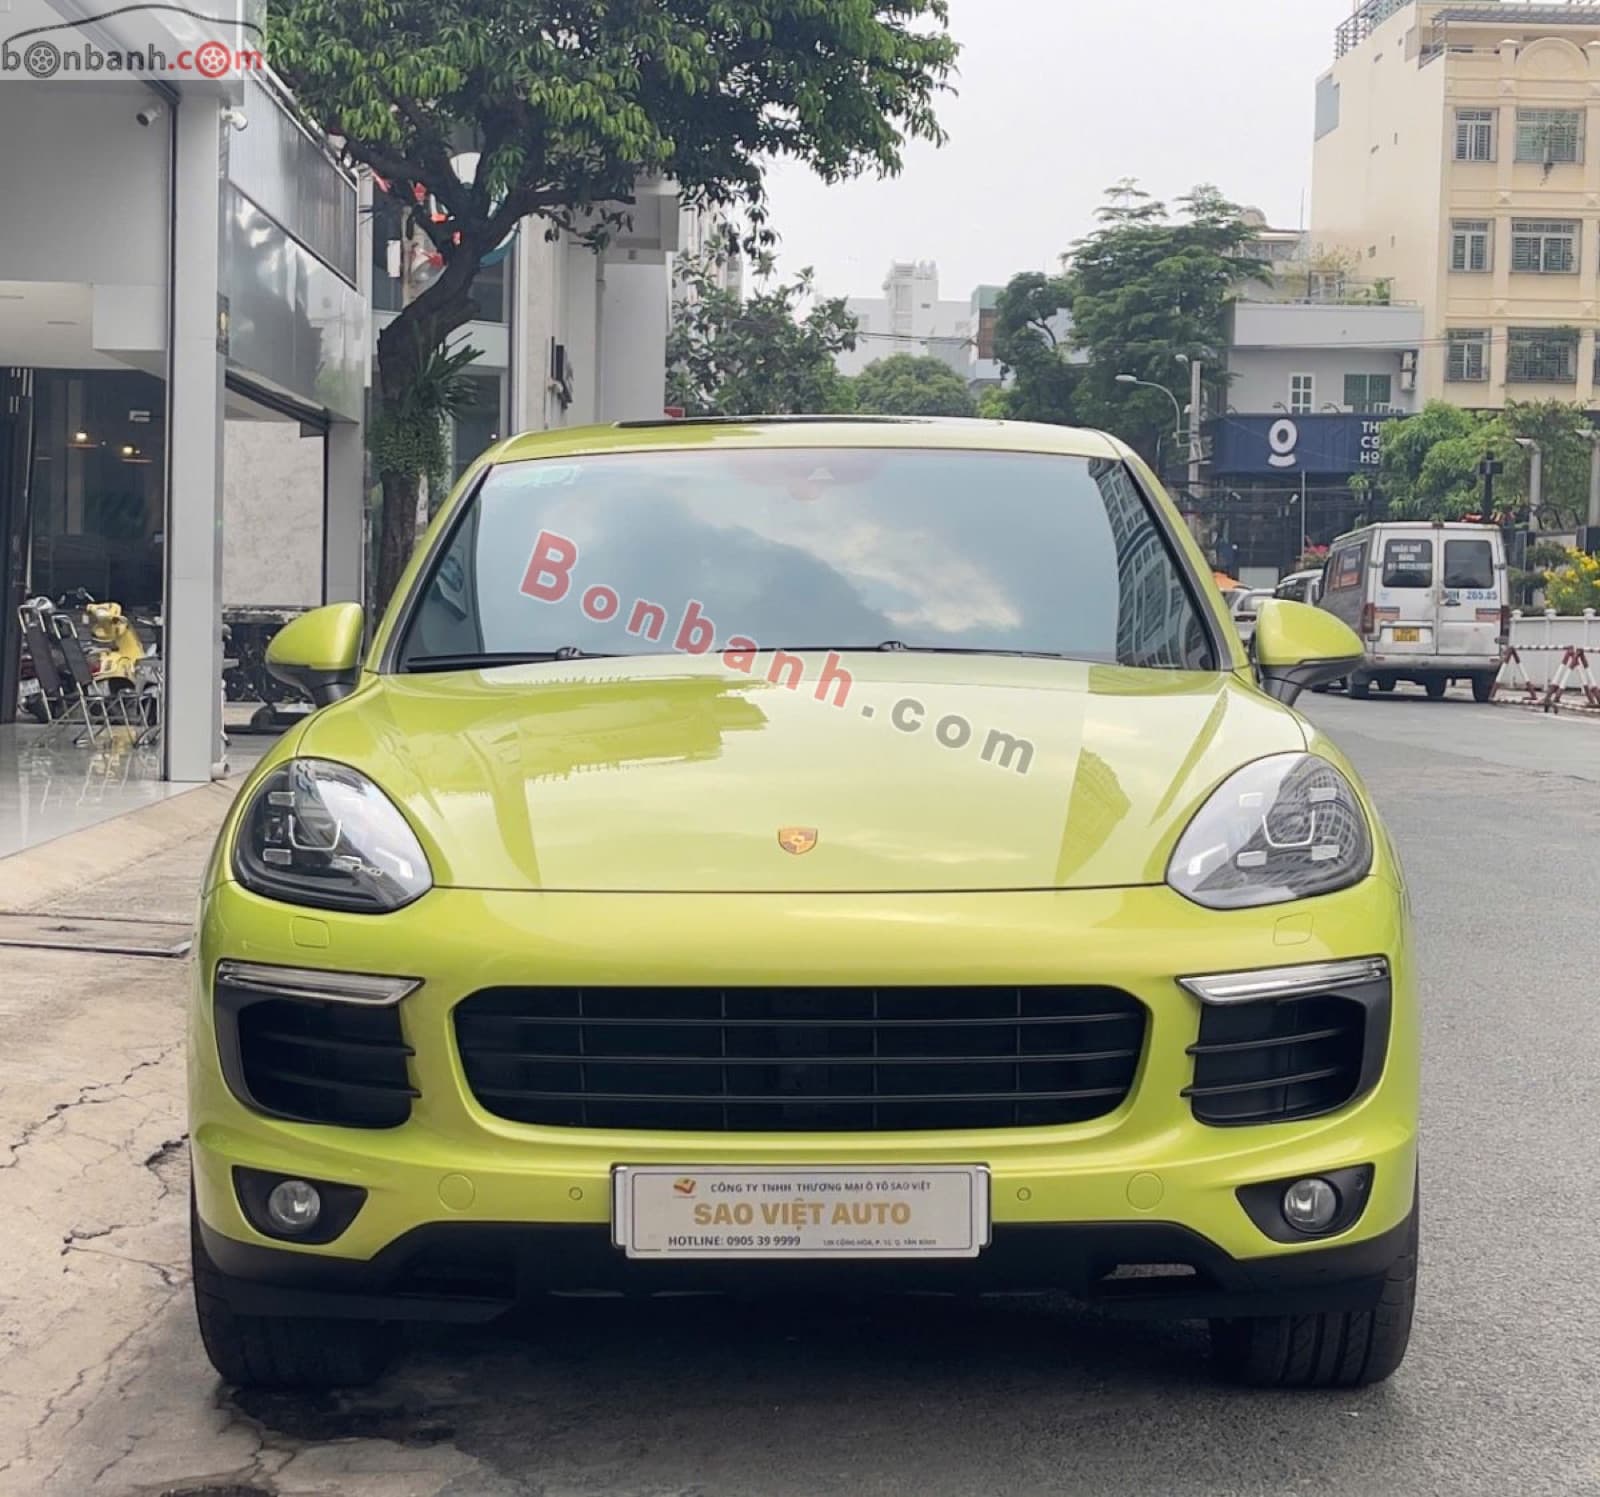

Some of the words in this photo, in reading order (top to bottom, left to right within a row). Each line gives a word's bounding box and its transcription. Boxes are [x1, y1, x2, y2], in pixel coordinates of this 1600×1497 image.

[710, 1181, 743, 1193] CÔNG
[745, 1183, 759, 1193] TY
[761, 1183, 792, 1193] TNHH
[797, 1181, 842, 1193] THƯƠNG
[845, 1183, 864, 1194] MẠI
[865, 1180, 874, 1192] Ô
[875, 1180, 889, 1192] TÔ
[890, 1183, 910, 1192] SAO
[912, 1180, 932, 1193] VIỆT
[694, 1203, 754, 1226] SAO
[760, 1198, 825, 1231] VIỆT
[831, 1203, 911, 1226] AUTO
[668, 1235, 724, 1247] HOTLINE:
[726, 1235, 754, 1247] 0905
[756, 1235, 771, 1247] 39
[773, 1235, 801, 1247] 9999
